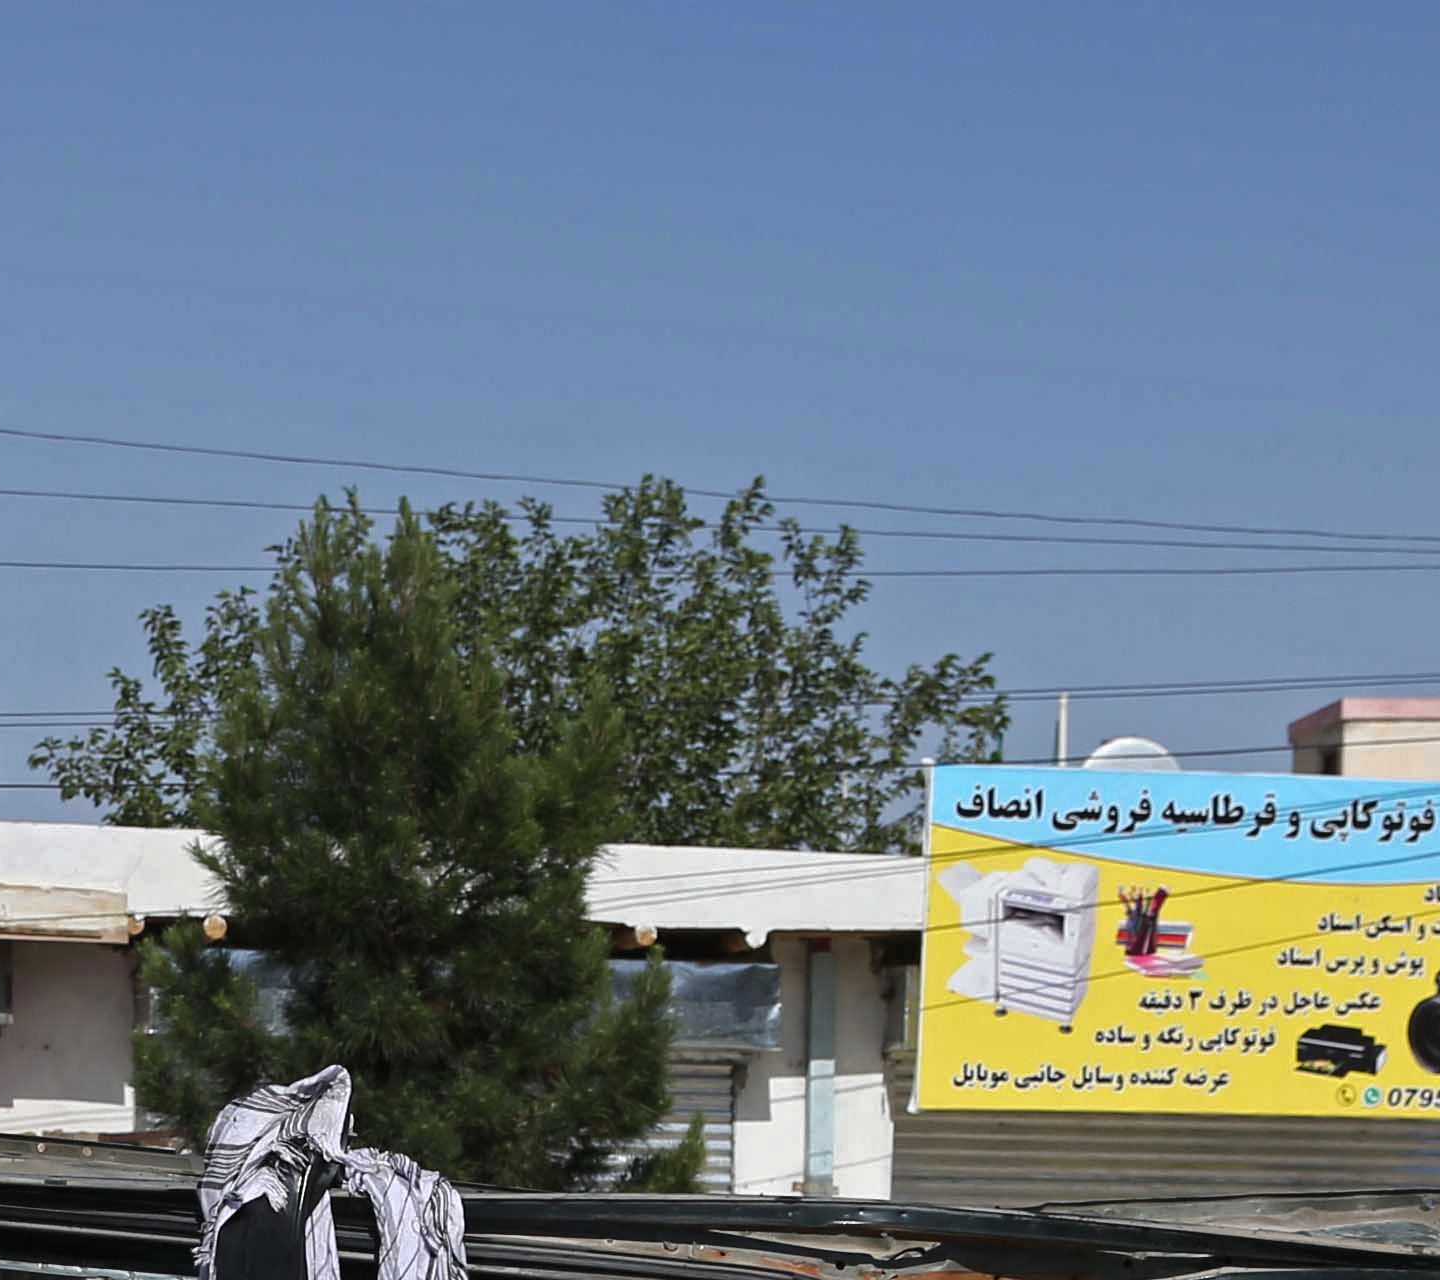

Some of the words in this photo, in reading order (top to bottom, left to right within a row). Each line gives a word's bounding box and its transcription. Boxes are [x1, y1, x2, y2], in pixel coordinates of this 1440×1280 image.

[956, 785, 1044, 819] انصاف
[1052, 789, 1153, 833] فروشی
[1161, 793, 1276, 838] قرطاسیه
[1285, 811, 1301, 837] و
[1317, 912, 1361, 932] اسناد
[1416, 923, 1426, 940] و
[1277, 947, 1320, 966] اسناد
[1369, 958, 1380, 975] و
[1138, 988, 1183, 1016] دقیقه
[1208, 989, 1252, 1016] ظرف
[1258, 993, 1278, 1016] در
[1283, 991, 1331, 1014] عاجل
[1335, 991, 1382, 1015] عکس
[1094, 1025, 1136, 1044] ساده
[1140, 1032, 1151, 1050] و
[952, 1062, 1009, 1088] موبایل
[1013, 1062, 1067, 1090] جانبی
[1128, 1067, 1177, 1087] کننده
[1182, 1068, 1229, 1092] عرضه
